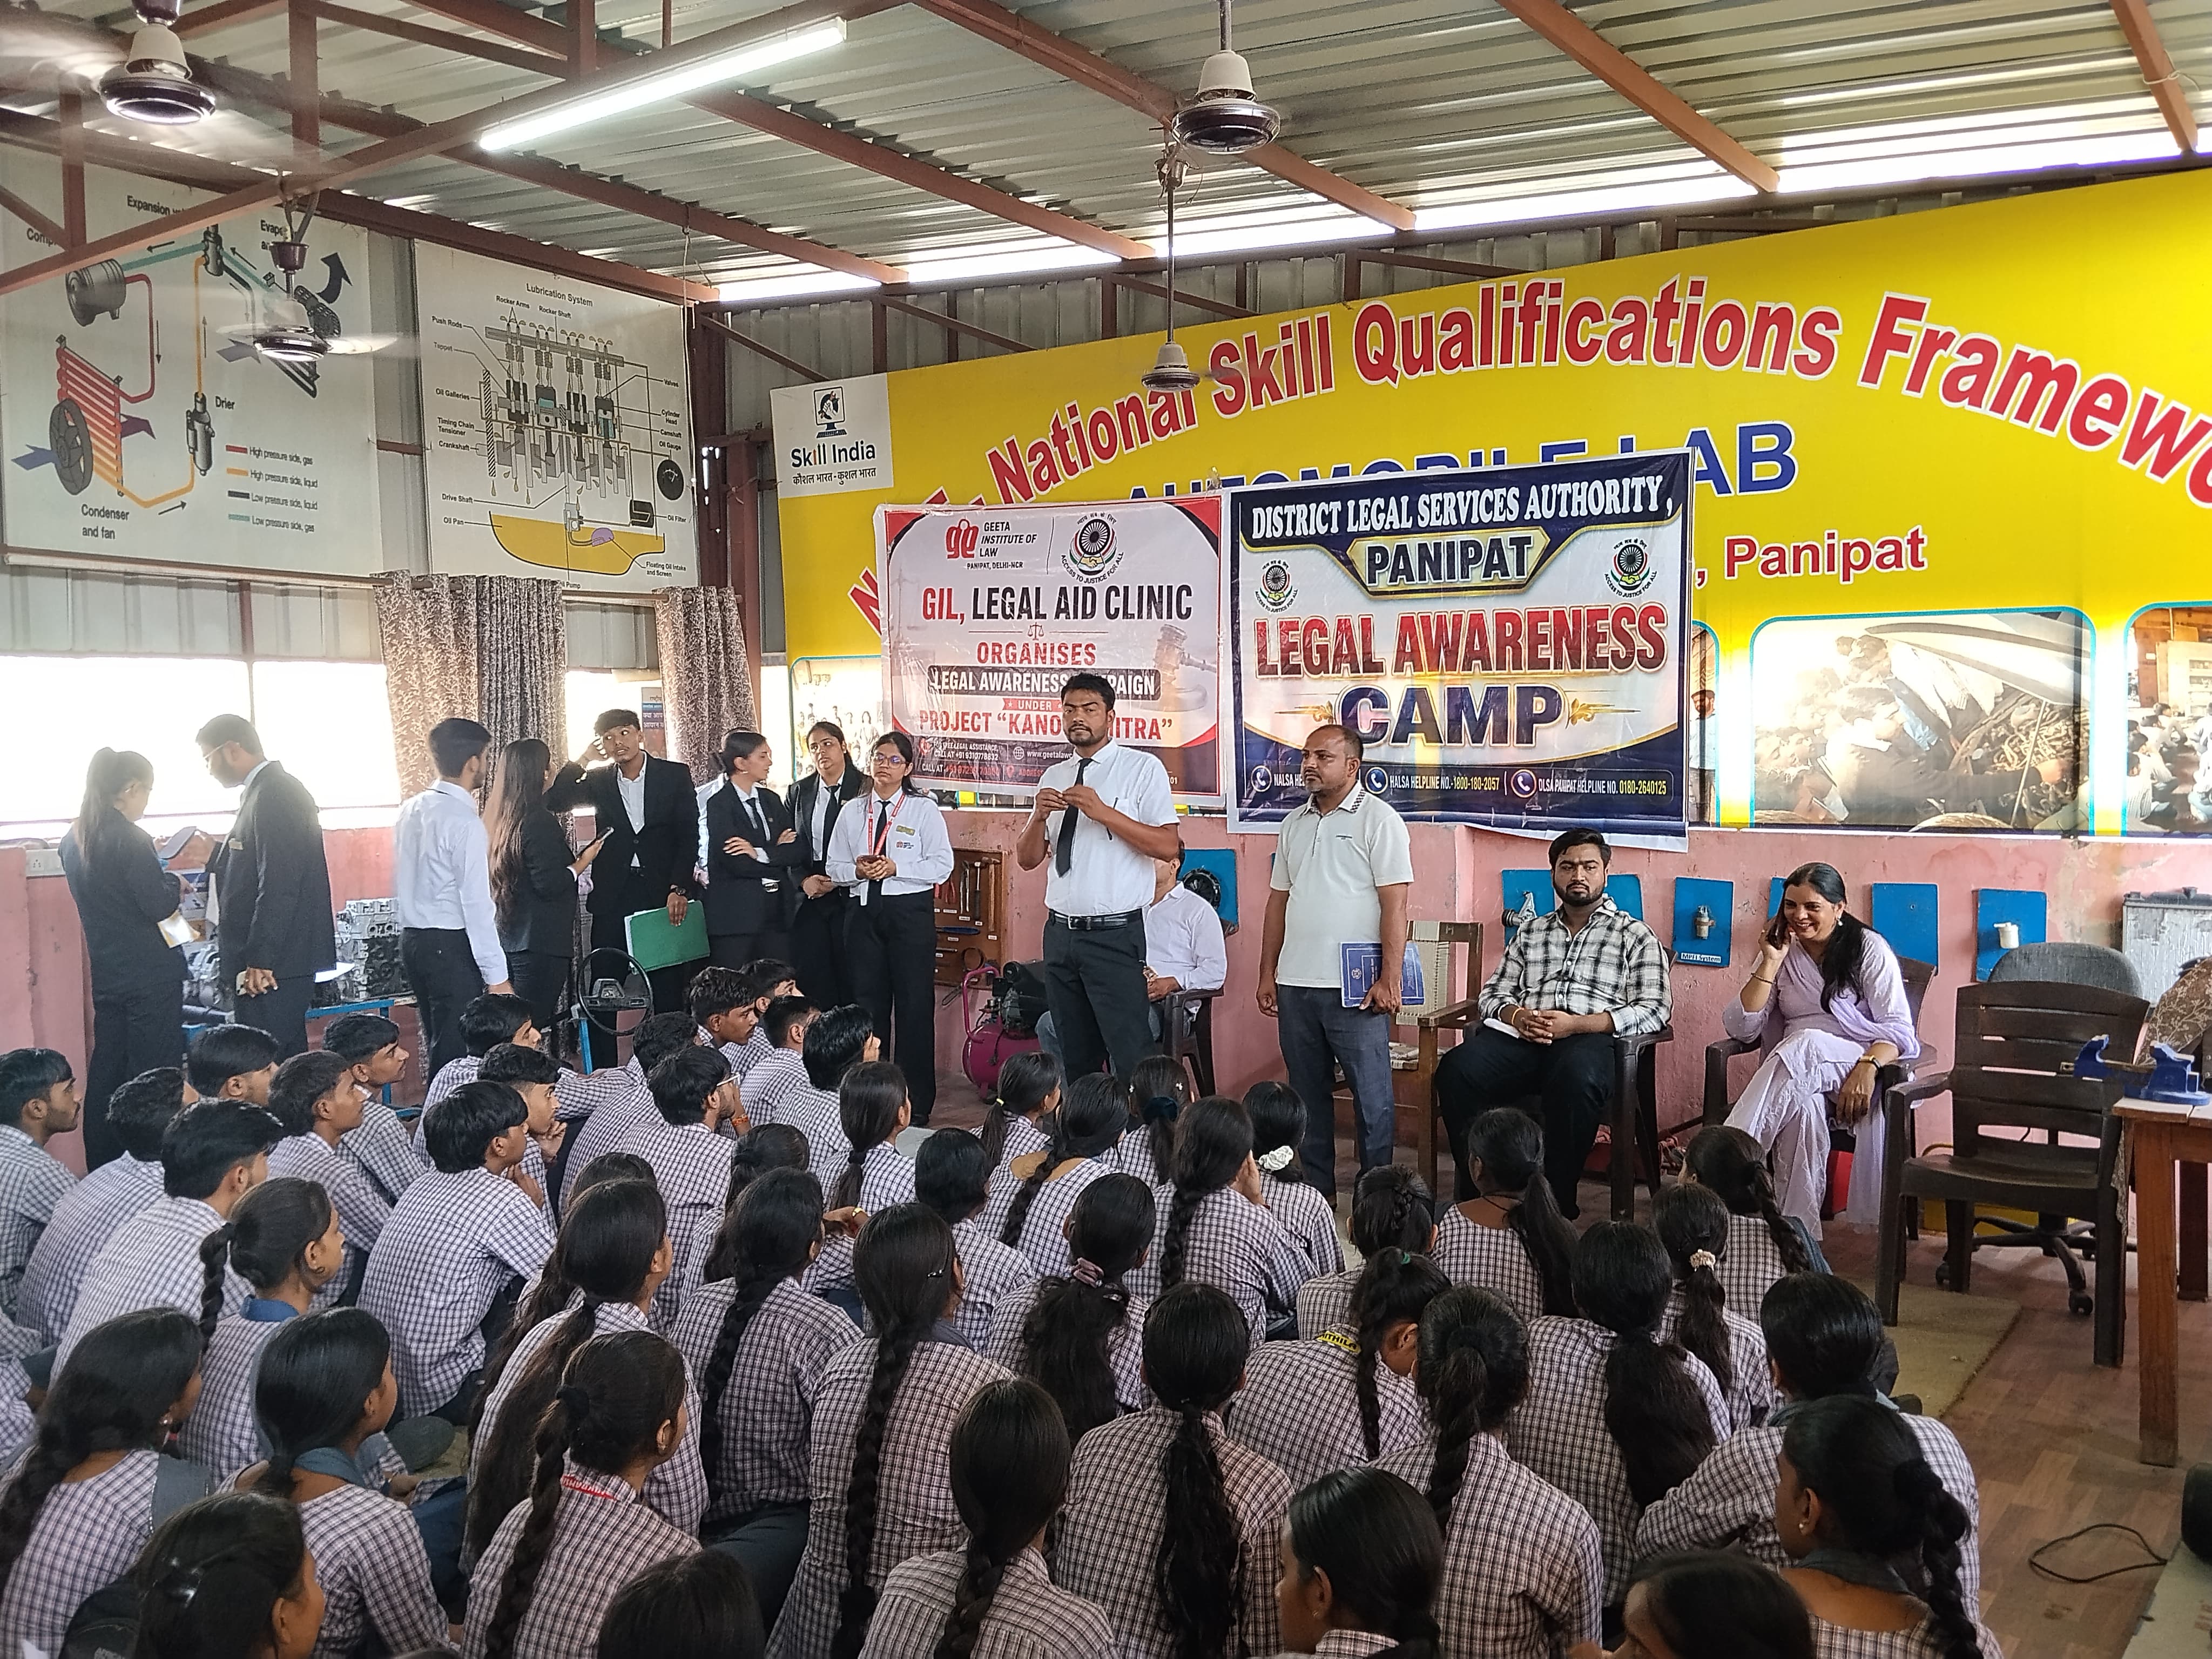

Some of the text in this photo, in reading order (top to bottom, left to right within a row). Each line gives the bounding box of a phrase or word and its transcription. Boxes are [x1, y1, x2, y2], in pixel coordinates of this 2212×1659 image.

[127, 195, 170, 215] Expansion
[496, 295, 530, 308] Rocker Arms
[526, 283, 593, 307] Lubrication System
[539, 306, 571, 319] Rocker Shaft
[432, 316, 462, 328] Push Rods
[1209, 312, 1336, 419] Skill
[1352, 273, 1843, 389] Qualifications
[216, 396, 235, 410] Drier
[445, 390, 469, 400] Galleries
[661, 409, 680, 419] Cylinder
[437, 417, 474, 429] Timing Chain
[438, 426, 466, 436] Tensioner
[660, 429, 682, 438] Camshaft
[439, 440, 470, 450] Crankshaft
[249, 447, 313, 466] High pressure side, gas
[791, 440, 875, 468] Skill India
[251, 469, 318, 488] High pressure side, liquid
[793, 473, 814, 485] कौशल
[859, 468, 876, 478] भारत
[252, 493, 318, 510] Low pressure side, liquid
[442, 494, 457, 502] Drive
[82, 504, 129, 521] Condenser
[1252, 503, 1340, 539] DISTRICT
[1347, 495, 1413, 531] LEGAL
[1419, 485, 1520, 526] SERVICES
[82, 526, 116, 539] and fan
[252, 516, 314, 533] Low pressure side, gas
[984, 522, 1010, 531] GEETA
[981, 534, 1037, 544] INSTITUTE OF
[980, 548, 998, 557] LAW
[1366, 535, 1533, 585] PANIPAT
[1724, 525, 1928, 584] Panipat
[646, 562, 664, 570] Floating
[967, 562, 991, 570] PANIPAT,
[1061, 555, 1076, 577] ACCESS
[1084, 574, 1107, 583] JUSTICE
[1107, 564, 1118, 576] FOR
[1116, 552, 1124, 565] ALL
[1604, 574, 1617, 592] ACCESS
[1622, 590, 1642, 598] JUSTICE
[1642, 582, 1652, 591] FOR
[922, 588, 966, 625] GIL,
[972, 586, 1047, 620] LEGAL
[1054, 585, 1097, 620] AID
[1105, 584, 1192, 621] CLINIC
[1254, 602, 1669, 679] LEGAL AWARENESS
[977, 642, 1097, 665] ORGANISES
[934, 673, 975, 691] LEGAL
[1018, 700, 1053, 711] UNDER
[1336, 681, 1570, 747] CAMP
[920, 711, 992, 733] PROJECT
[922, 764, 934, 772] CALL
[936, 765, 943, 773] AT
[1273, 773, 1294, 786] NALSA
[1390, 776, 1410, 789] HALSA
[1411, 776, 1440, 790] HELPLINE
[1539, 778, 1667, 795] DLSA PANIPAT HELPLINE NO. 0180-2640125
